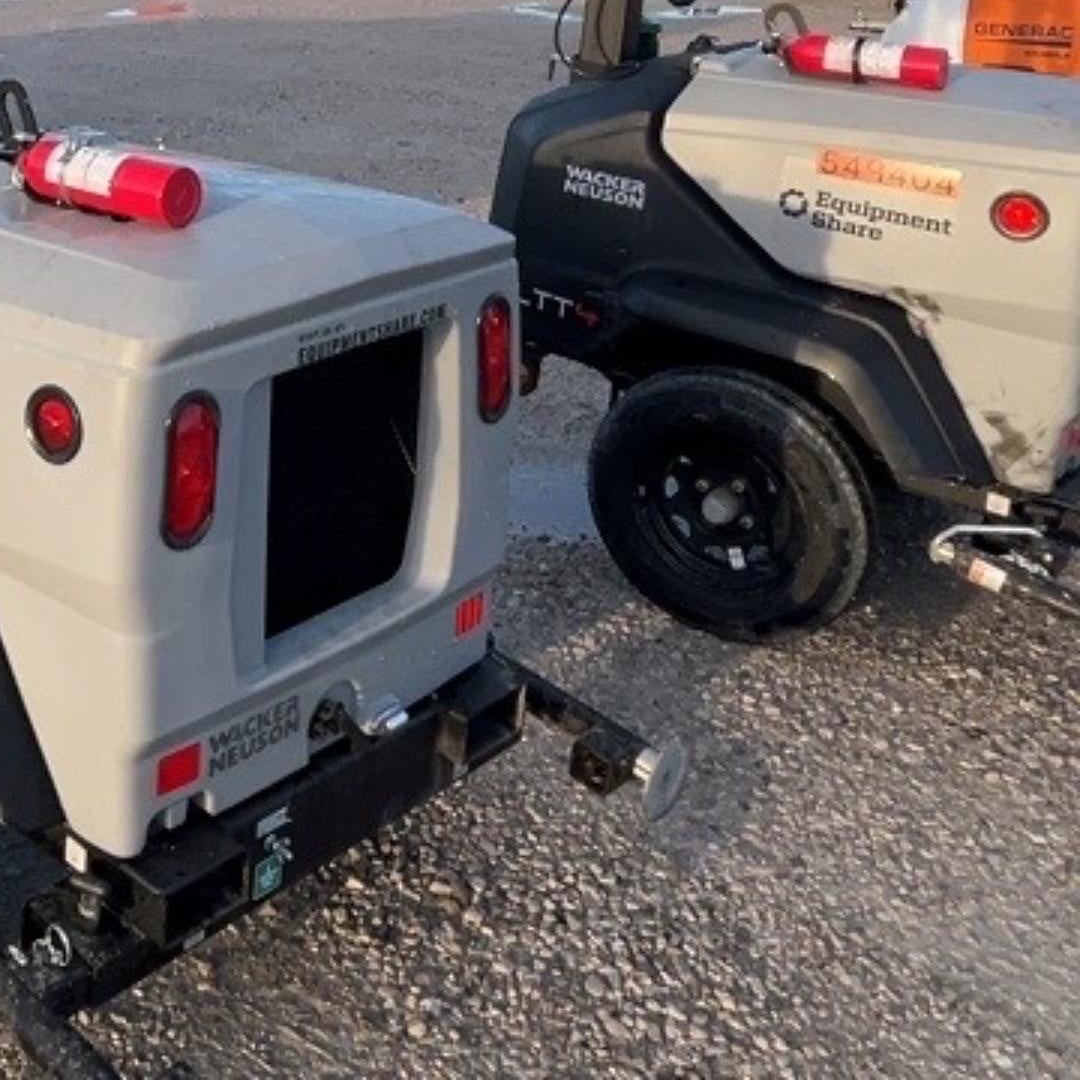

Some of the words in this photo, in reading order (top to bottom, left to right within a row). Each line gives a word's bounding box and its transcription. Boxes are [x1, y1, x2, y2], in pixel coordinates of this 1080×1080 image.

[563, 179, 644, 211] NEUSON
[565, 164, 646, 196] WACKER
[809, 210, 883, 240] Share
[816, 190, 953, 235] Equipment
[209, 695, 301, 754] WACKER
